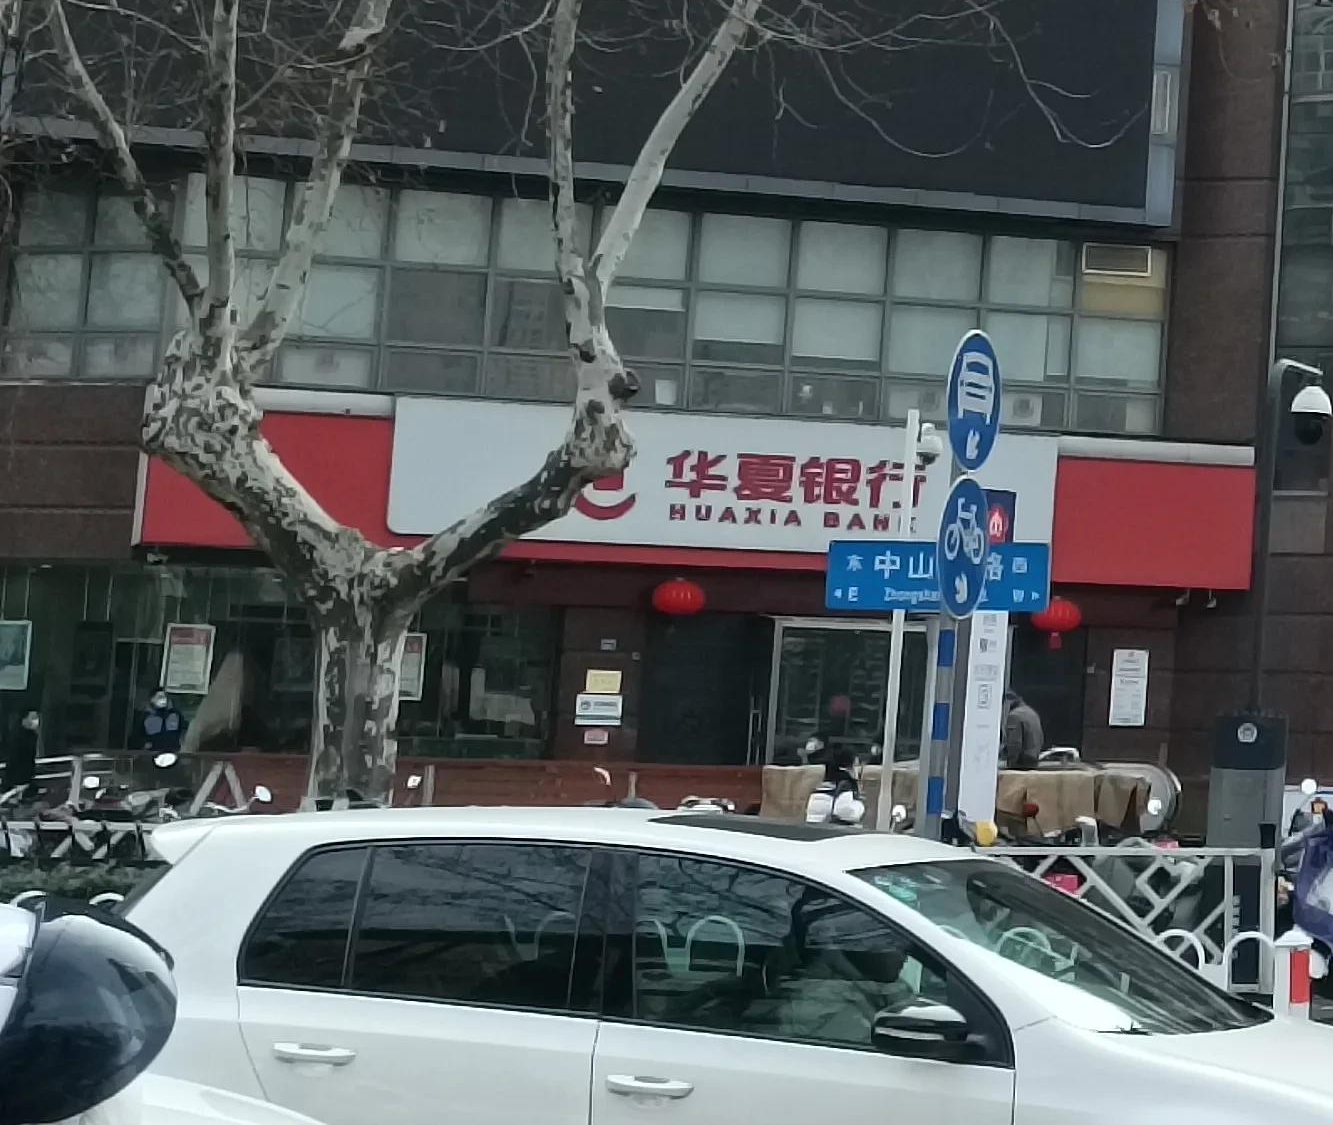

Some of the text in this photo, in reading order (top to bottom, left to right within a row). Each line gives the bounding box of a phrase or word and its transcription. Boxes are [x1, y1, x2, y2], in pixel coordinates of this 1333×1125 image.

[665, 450, 927, 509] 华夏银行
[669, 503, 802, 527] HUAXIA
[873, 550, 1004, 581] 中山路
